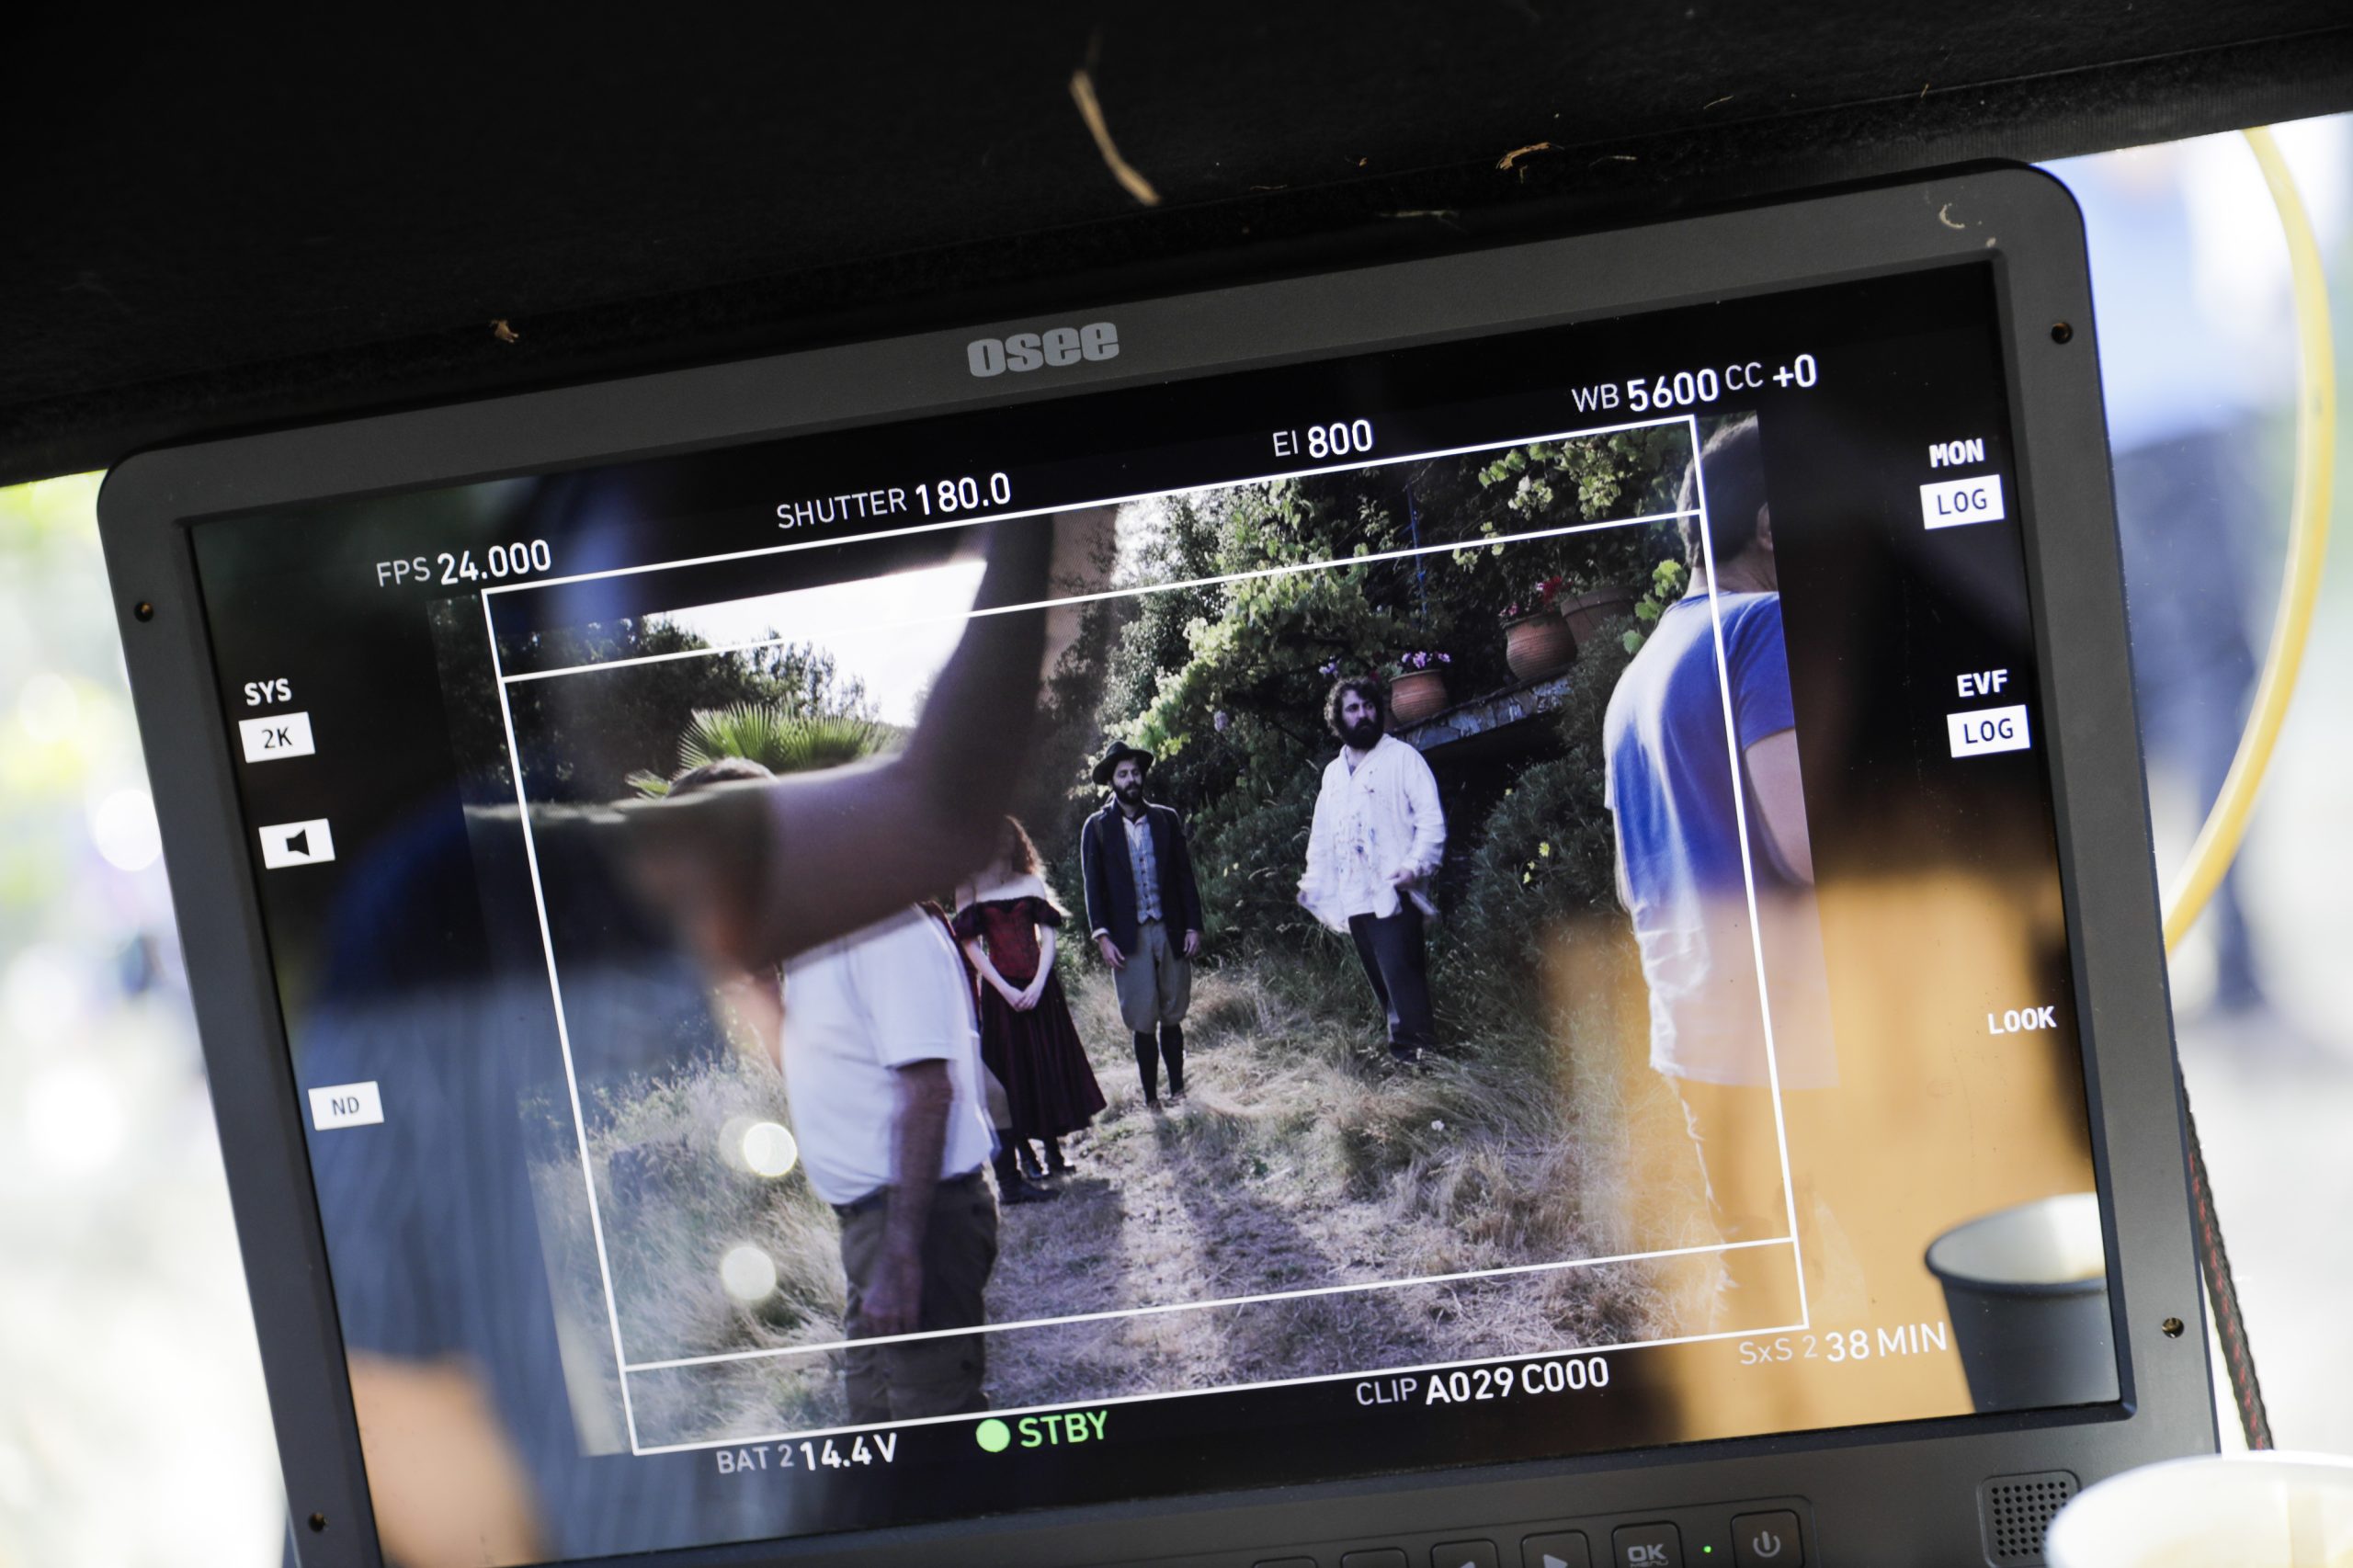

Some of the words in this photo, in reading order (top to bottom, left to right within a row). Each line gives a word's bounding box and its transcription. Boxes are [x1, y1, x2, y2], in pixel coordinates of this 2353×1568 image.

[1572, 384, 1620, 414] WB
[1626, 368, 1720, 414] 5600
[1724, 361, 1764, 392] CC
[1772, 354, 1817, 390] +0
[1272, 430, 1299, 458] EI
[1307, 419, 1373, 459] 800
[1928, 437, 1985, 468] MON
[777, 487, 908, 529] SHUTTER
[915, 472, 1012, 517] 180.0
[1936, 487, 1989, 517] LOG
[376, 560, 432, 587] FPS
[437, 540, 552, 585] 24.000
[244, 678, 293, 706] SYS
[1956, 668, 2009, 698] EVF
[263, 726, 294, 750] 2K
[1963, 718, 2015, 744] LOG
[1987, 1006, 2058, 1035] LOOK
[331, 1096, 361, 1117] ND
[1738, 1337, 1793, 1366] SxS
[1802, 1335, 1819, 1359] 2
[1824, 1329, 1871, 1363] 38
[1876, 1321, 1949, 1358] MIN
[1355, 1379, 1417, 1406] CLIP
[1425, 1364, 1514, 1406] A029
[1521, 1357, 1610, 1396] C000
[1018, 1410, 1108, 1449] STBY
[716, 1446, 770, 1474] BAT
[779, 1444, 794, 1467] 2
[1627, 1543, 1667, 1562] OK
